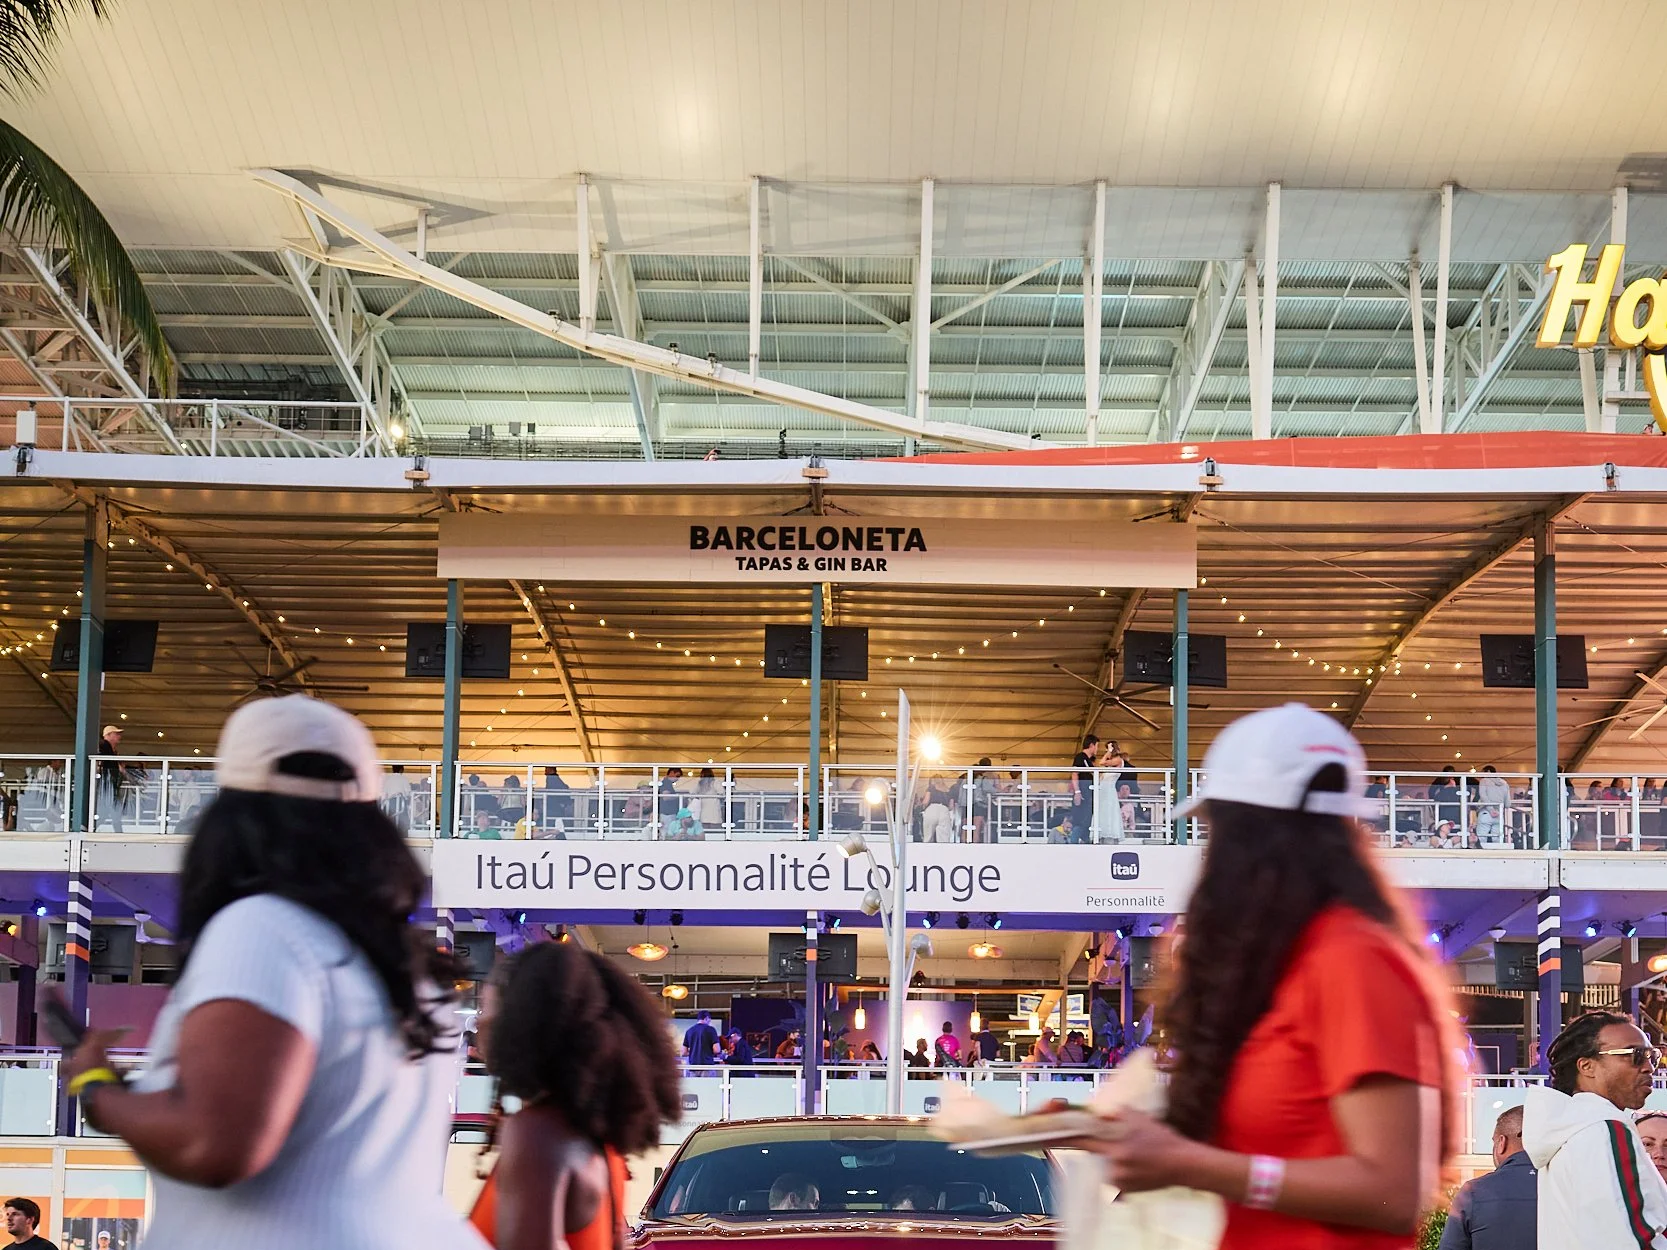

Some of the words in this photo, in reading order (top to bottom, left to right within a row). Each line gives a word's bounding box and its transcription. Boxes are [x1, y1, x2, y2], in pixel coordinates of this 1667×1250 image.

[689, 525, 928, 552] BARCELONETA
[735, 556, 793, 571] TAPAS
[796, 557, 810, 571] &
[814, 557, 846, 571] GIN
[851, 558, 888, 572] BAR
[476, 850, 554, 890] Itaú
[568, 852, 830, 891] Personnalité
